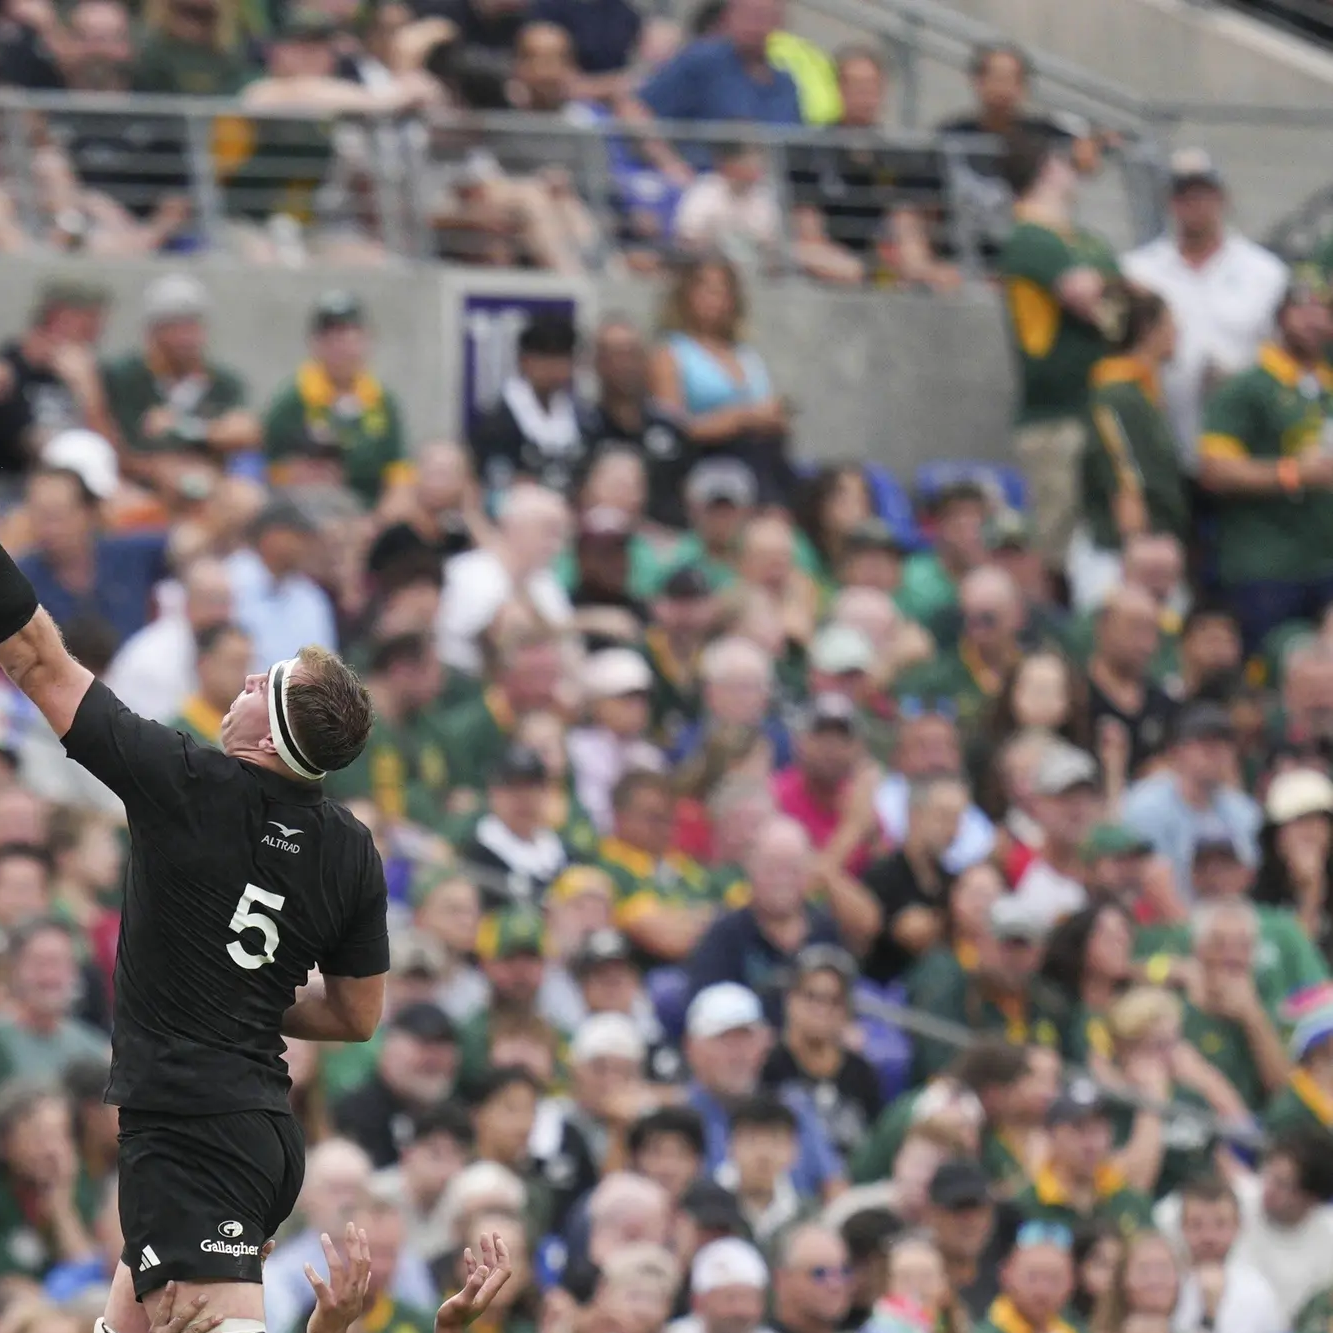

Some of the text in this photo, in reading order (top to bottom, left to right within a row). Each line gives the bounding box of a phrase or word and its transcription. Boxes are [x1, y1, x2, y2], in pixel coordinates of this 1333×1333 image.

[261, 834, 301, 854] ALTRAD
[225, 882, 286, 970] 5
[200, 1239, 259, 1257] Gallagher
